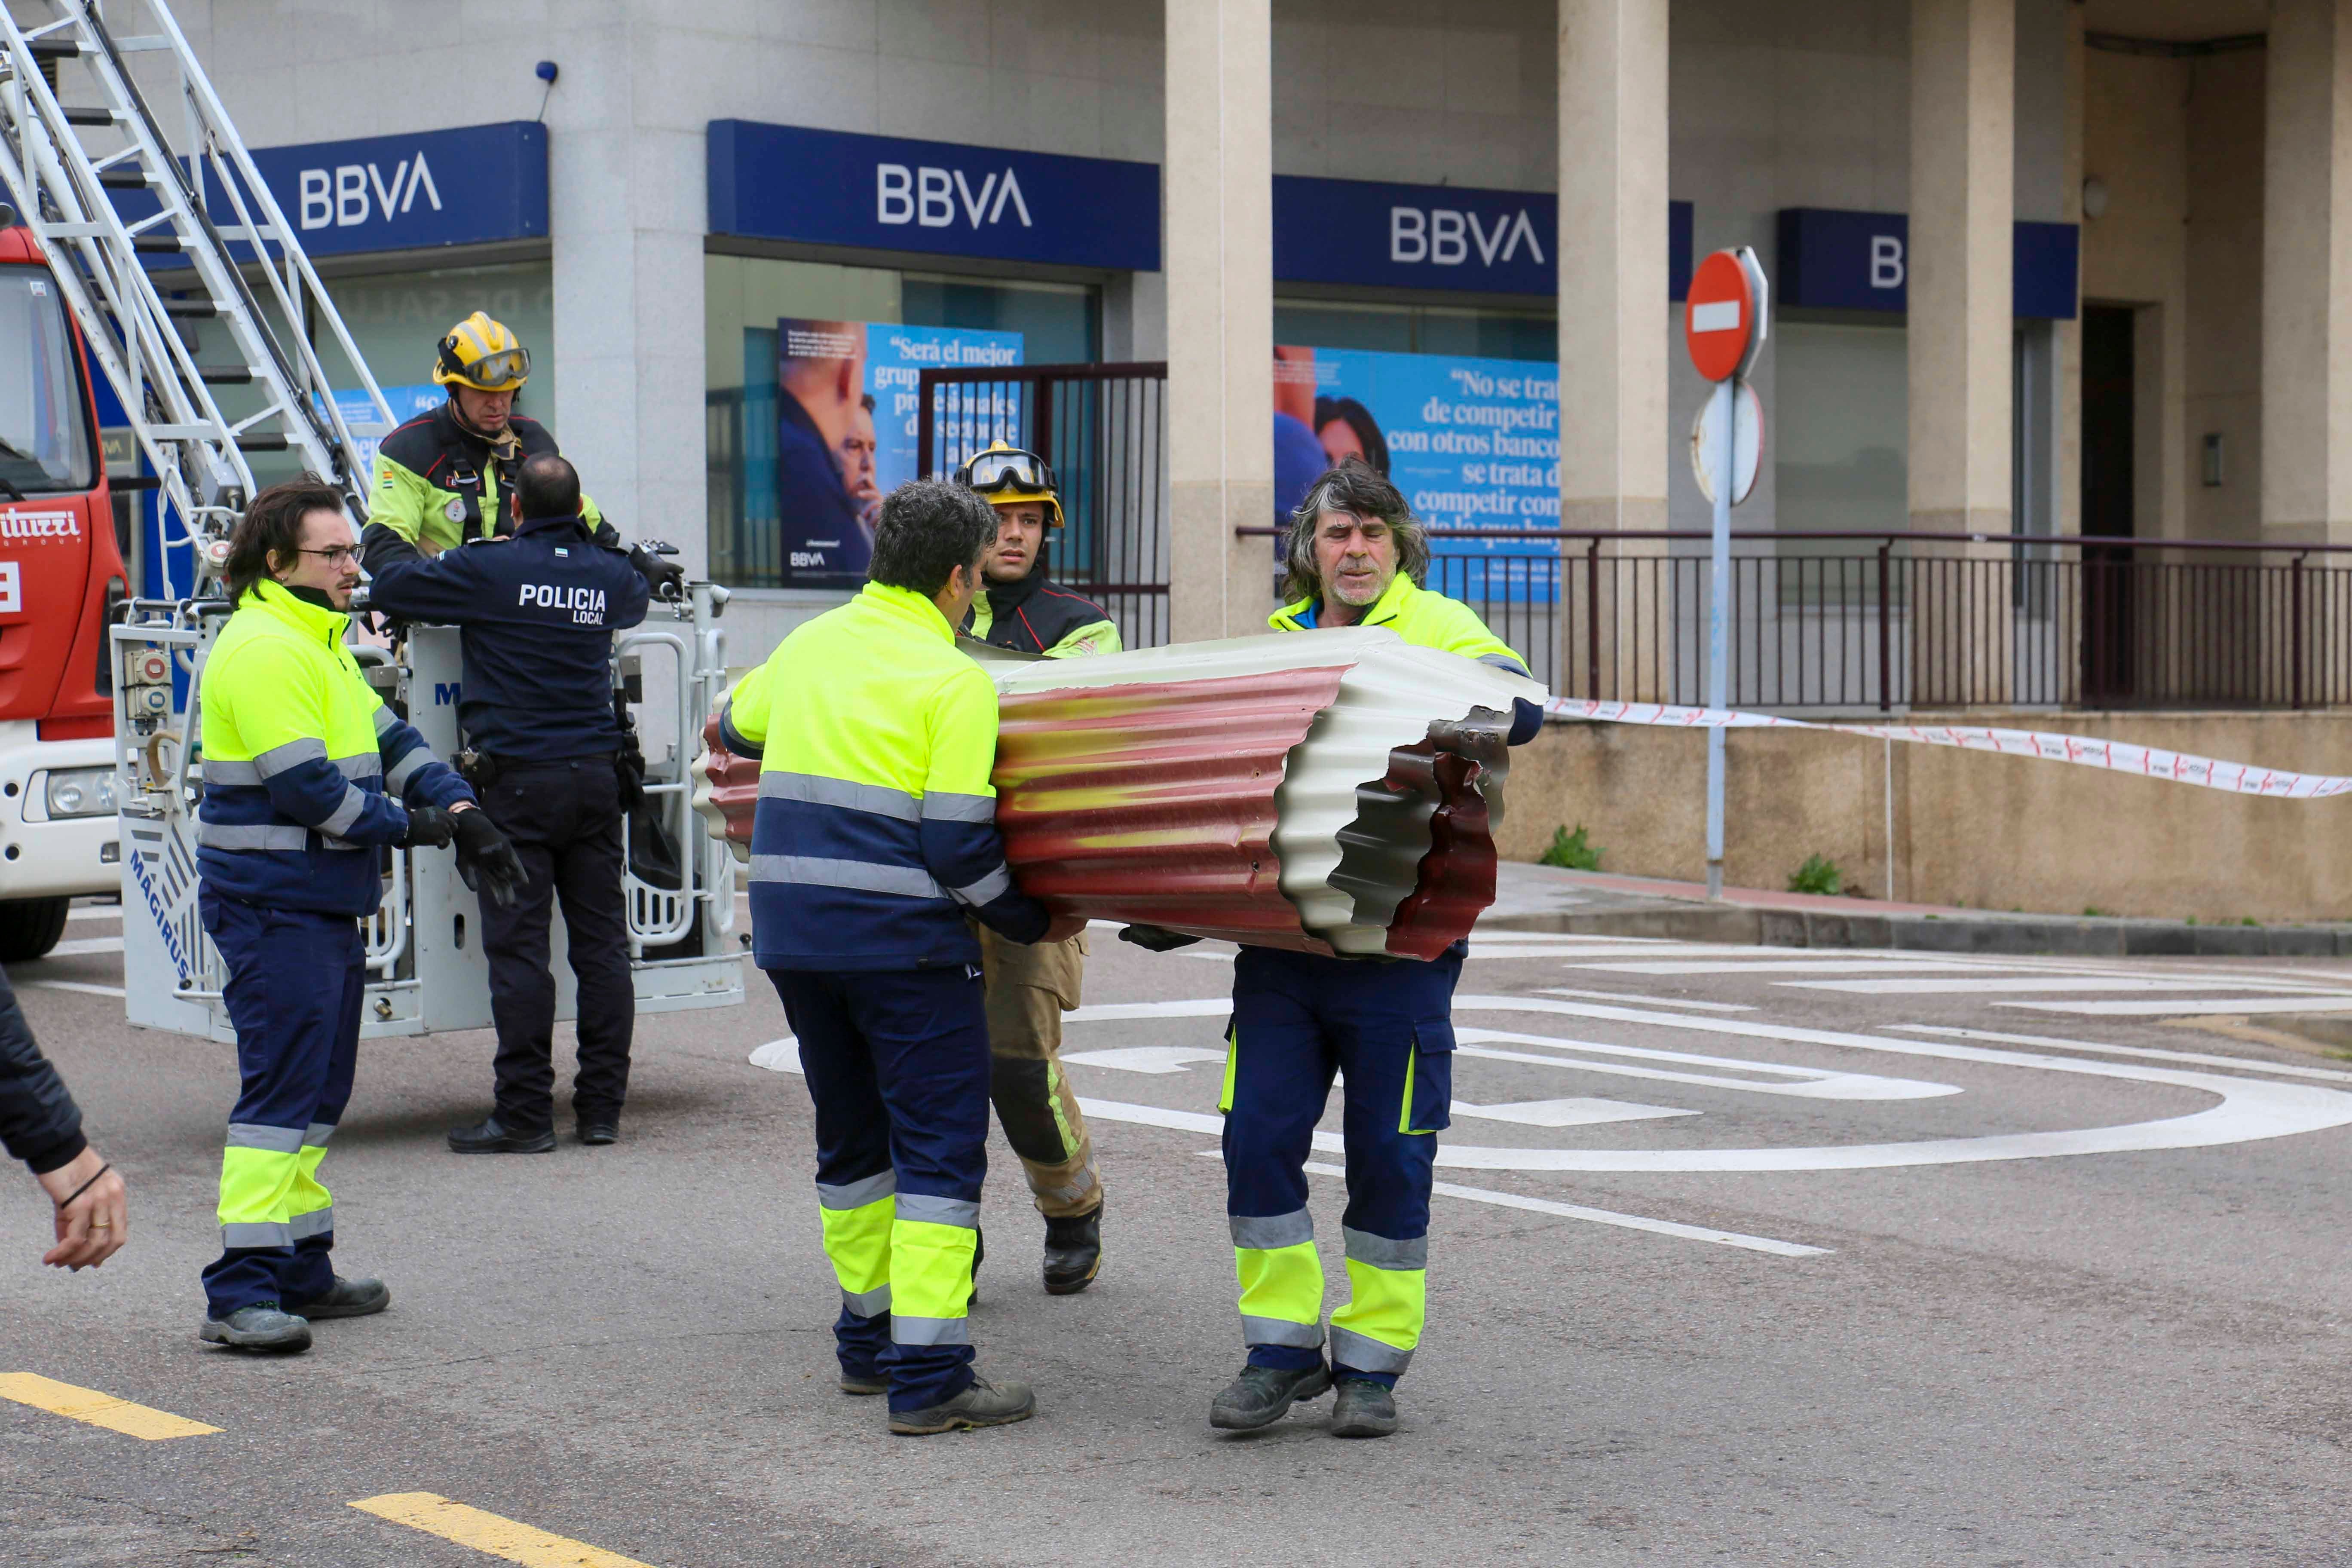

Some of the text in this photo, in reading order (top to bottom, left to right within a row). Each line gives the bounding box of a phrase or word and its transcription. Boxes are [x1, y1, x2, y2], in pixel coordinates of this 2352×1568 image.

[300, 150, 442, 230] BBVA
[877, 163, 1032, 230] BBVA
[1390, 208, 1545, 268] BBVA
[943, 339, 960, 362] el
[962, 342, 1017, 367] mejor
[874, 365, 920, 391] grup
[1497, 377, 1521, 399] se
[1524, 375, 1559, 401] tra
[1423, 396, 1556, 433] de competir
[1387, 430, 1560, 459] con otros banco
[1462, 463, 1486, 484] se
[1489, 463, 1543, 487] trata
[1414, 489, 1560, 518] competir con
[3, 537, 81, 547] GROUP
[790, 551, 825, 567] BBVA
[519, 584, 605, 612] POLICIA
[573, 610, 603, 625] LOCAL
[130, 848, 189, 980] MAGIRUS
